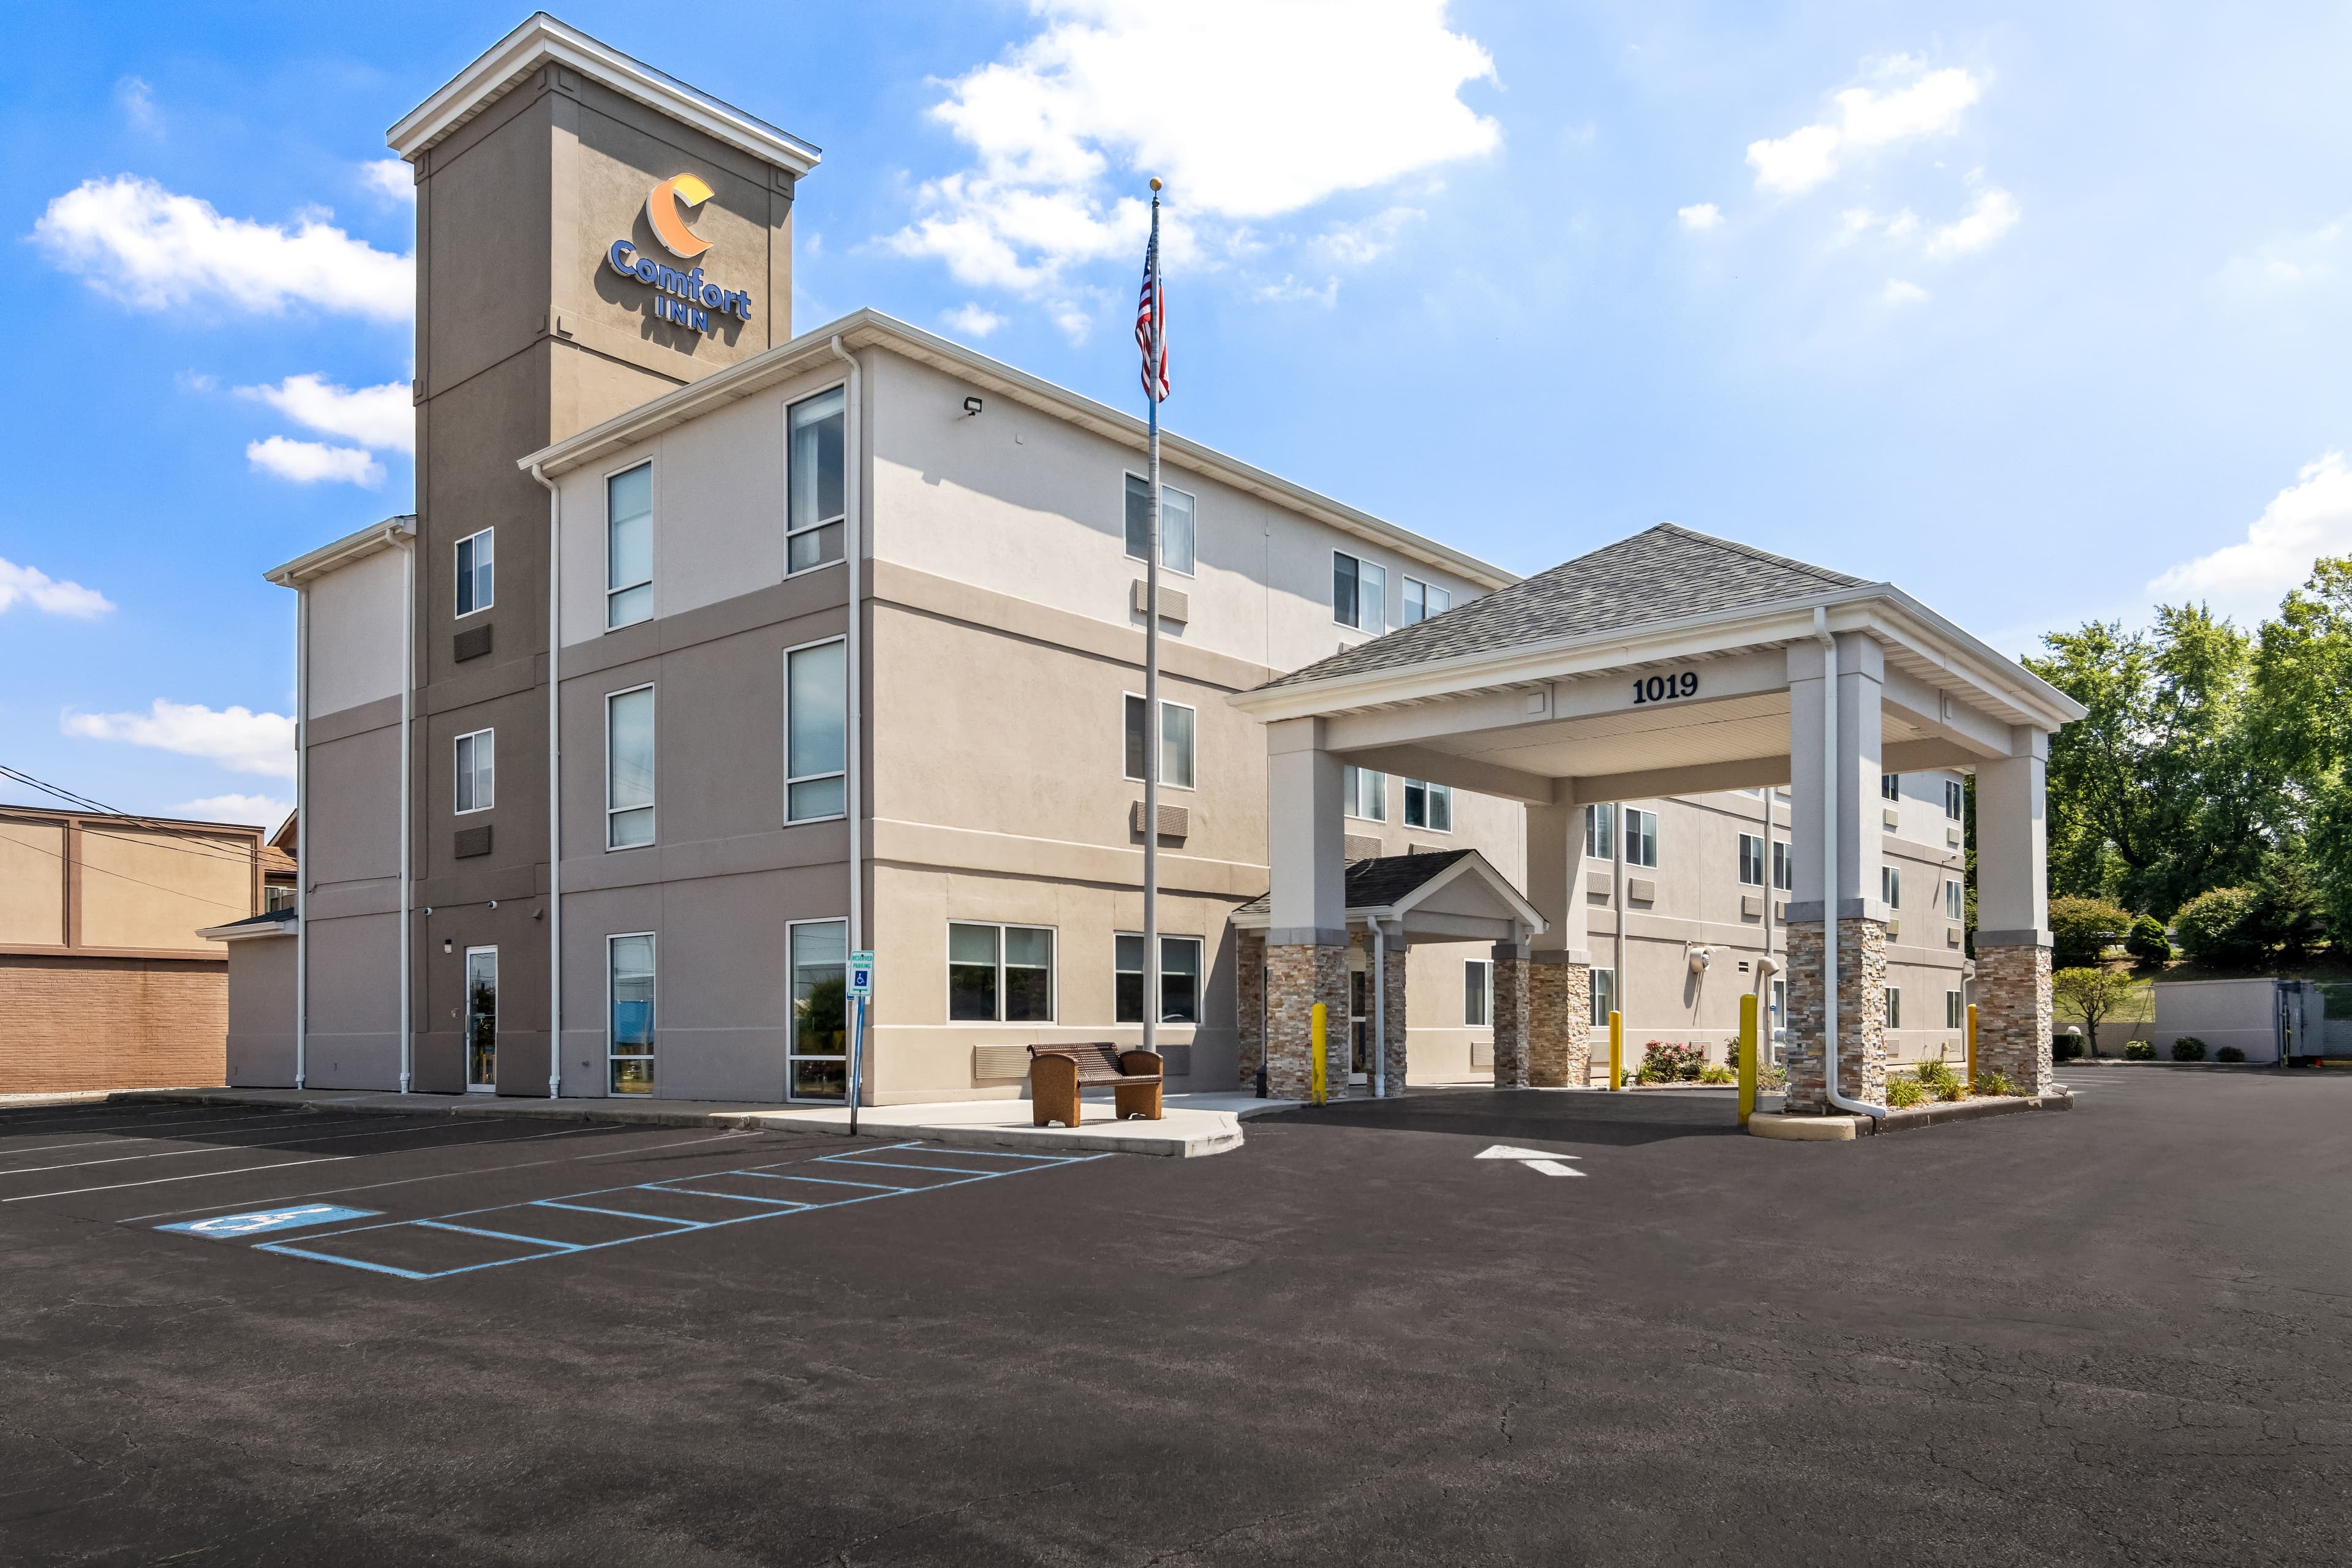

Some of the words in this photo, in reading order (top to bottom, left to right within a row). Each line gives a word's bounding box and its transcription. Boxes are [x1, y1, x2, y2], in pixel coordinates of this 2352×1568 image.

[608, 239, 751, 322] Comfort
[655, 295, 708, 333] INN
[1633, 672, 1698, 704] 1019
